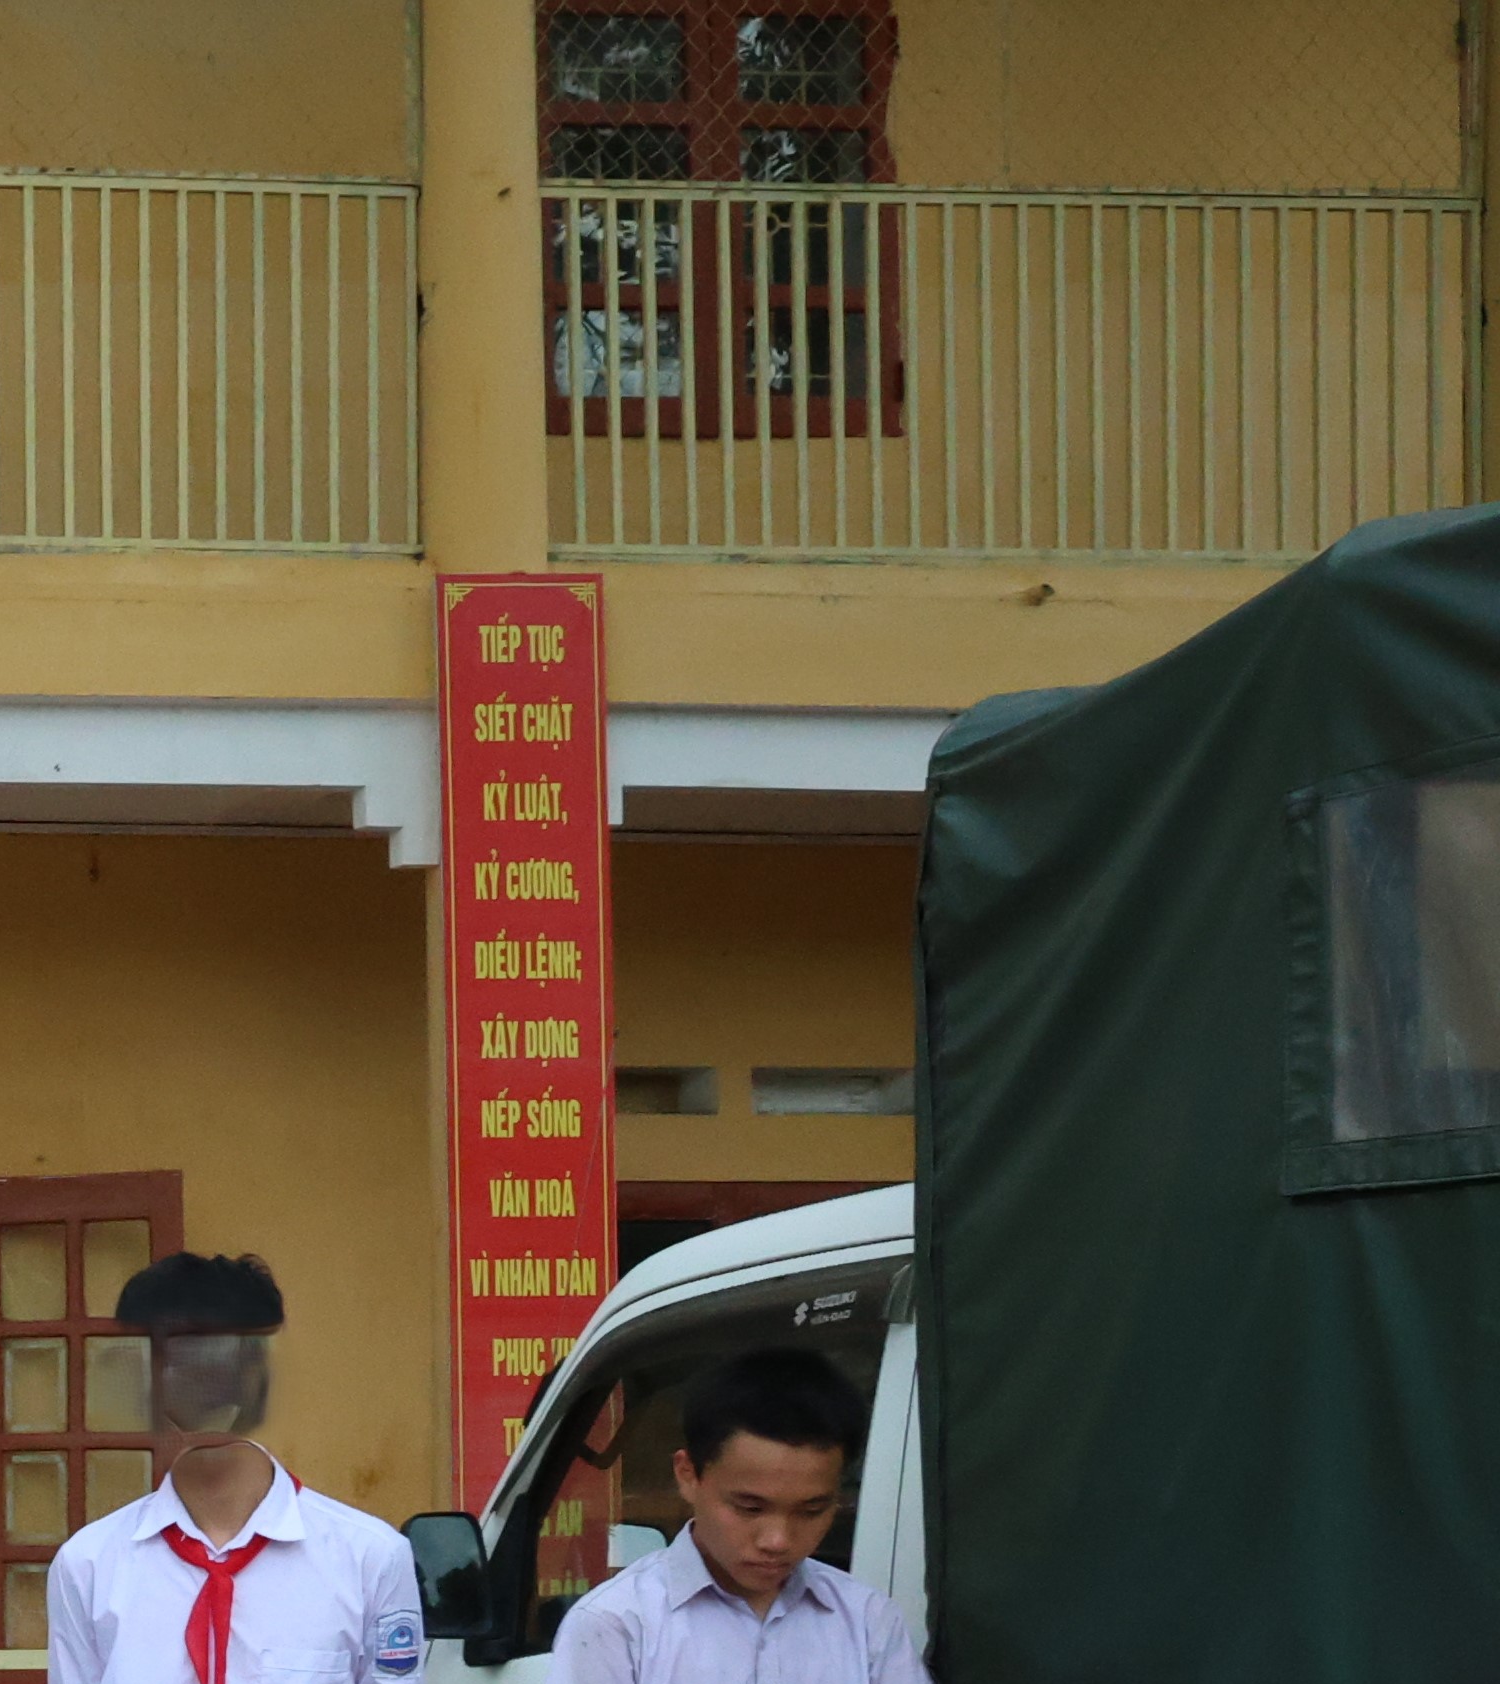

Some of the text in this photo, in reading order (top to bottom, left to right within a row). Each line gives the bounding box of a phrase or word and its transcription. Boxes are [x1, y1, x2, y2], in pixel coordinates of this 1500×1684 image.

[479, 612, 565, 672] TIẾP TỤC
[474, 691, 573, 750] SIẾT CHẶT
[483, 769, 568, 829] KỶ LUẬT,
[474, 849, 580, 905] KỶ CƯƠNG,
[525, 932, 582, 988] LỆNH;
[481, 1012, 579, 1067] XÂY DỰNG
[481, 1085, 581, 1138] NẾP SỐNG
[489, 1172, 575, 1217] VĂN HOÁ
[469, 1250, 597, 1297] VÌ NHÂN DÂN
[492, 1337, 546, 1386] PHỤC
